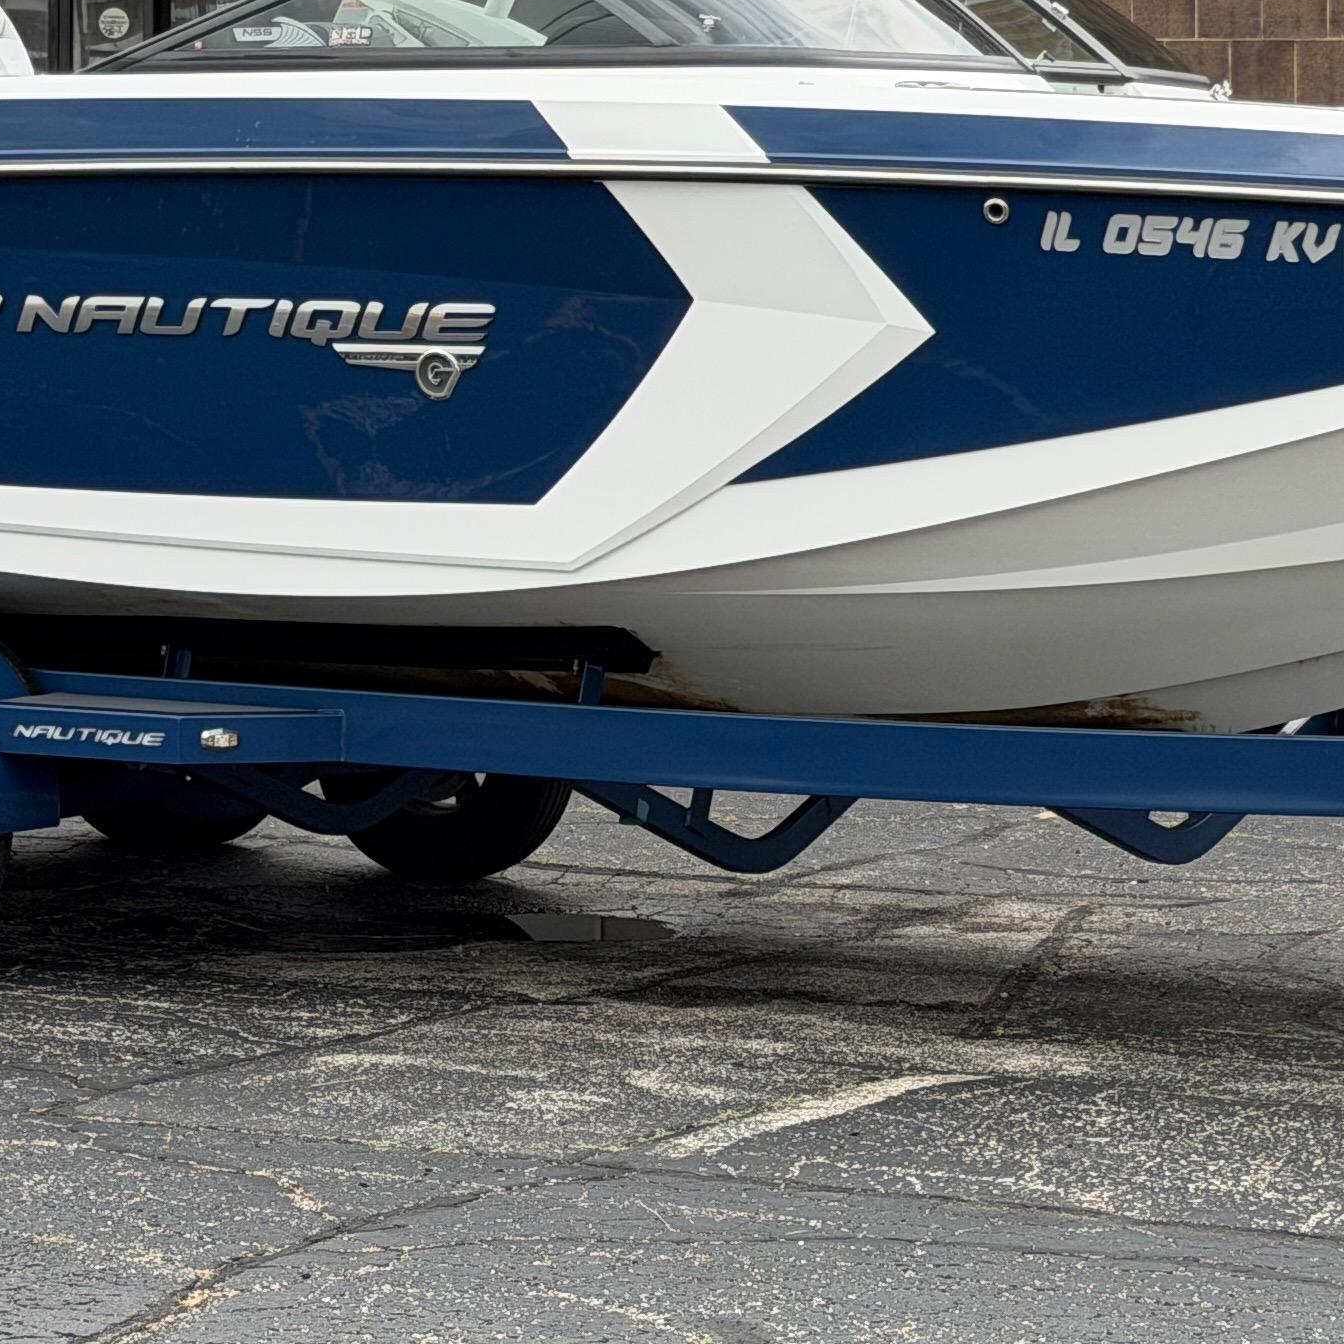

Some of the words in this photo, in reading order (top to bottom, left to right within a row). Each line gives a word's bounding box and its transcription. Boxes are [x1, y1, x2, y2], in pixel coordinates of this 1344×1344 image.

[1040, 210, 1081, 253] IL
[1102, 213, 1251, 260] 0546
[1265, 220, 1342, 264] KV
[15, 294, 496, 347] NAUTIQUE
[13, 724, 166, 746] NAUTIQUE
